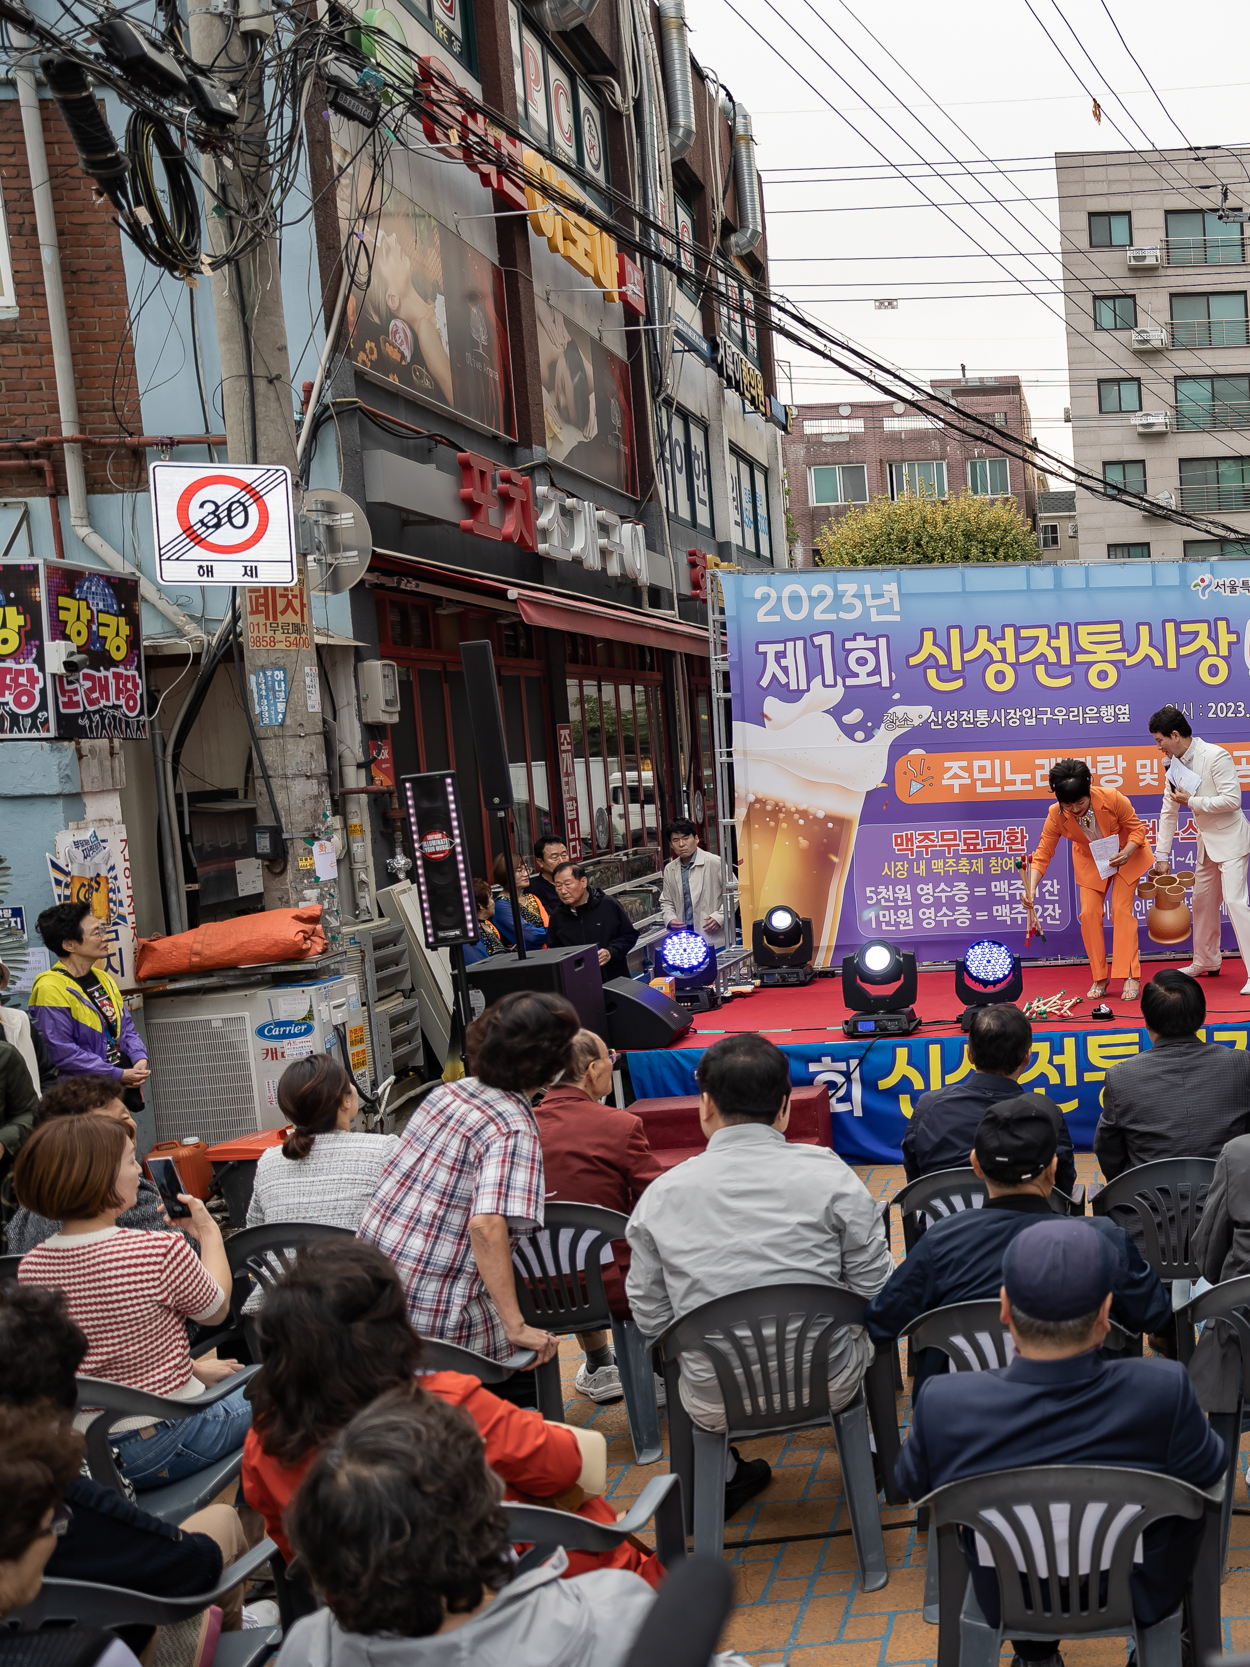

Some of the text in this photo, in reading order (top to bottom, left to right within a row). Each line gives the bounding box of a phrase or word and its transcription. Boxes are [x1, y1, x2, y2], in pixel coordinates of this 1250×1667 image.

[198, 500, 249, 530] 30
[457, 452, 650, 587] 포차 조개구이
[248, 586, 306, 622] 폐차
[754, 582, 901, 623] 2023년
[249, 621, 309, 636] 011 무료폐차
[250, 636, 310, 649] 9858-5400
[757, 632, 891, 691] 제1회
[908, 619, 1238, 692] 신성전통시장
[58, 670, 141, 717] 노래짱
[258, 671, 270, 724] 1544-3932
[882, 712, 914, 731] 장소
[927, 703, 1131, 730] 신성전통시장입구우리은행옆
[1207, 701, 1250, 719] 2023.
[1135, 757, 1159, 785] 및
[559, 729, 581, 859] 조개도매팝니다
[893, 826, 1028, 858] 맥주무료교환
[881, 860, 908, 878] 시장
[913, 859, 926, 876] 내
[931, 857, 984, 876] 맥주축제
[865, 884, 912, 906] 5천원
[916, 881, 970, 904] 영수증
[868, 907, 914, 931] 1만원
[918, 905, 972, 929] 영수증
[264, 1022, 308, 1037] Carrier
